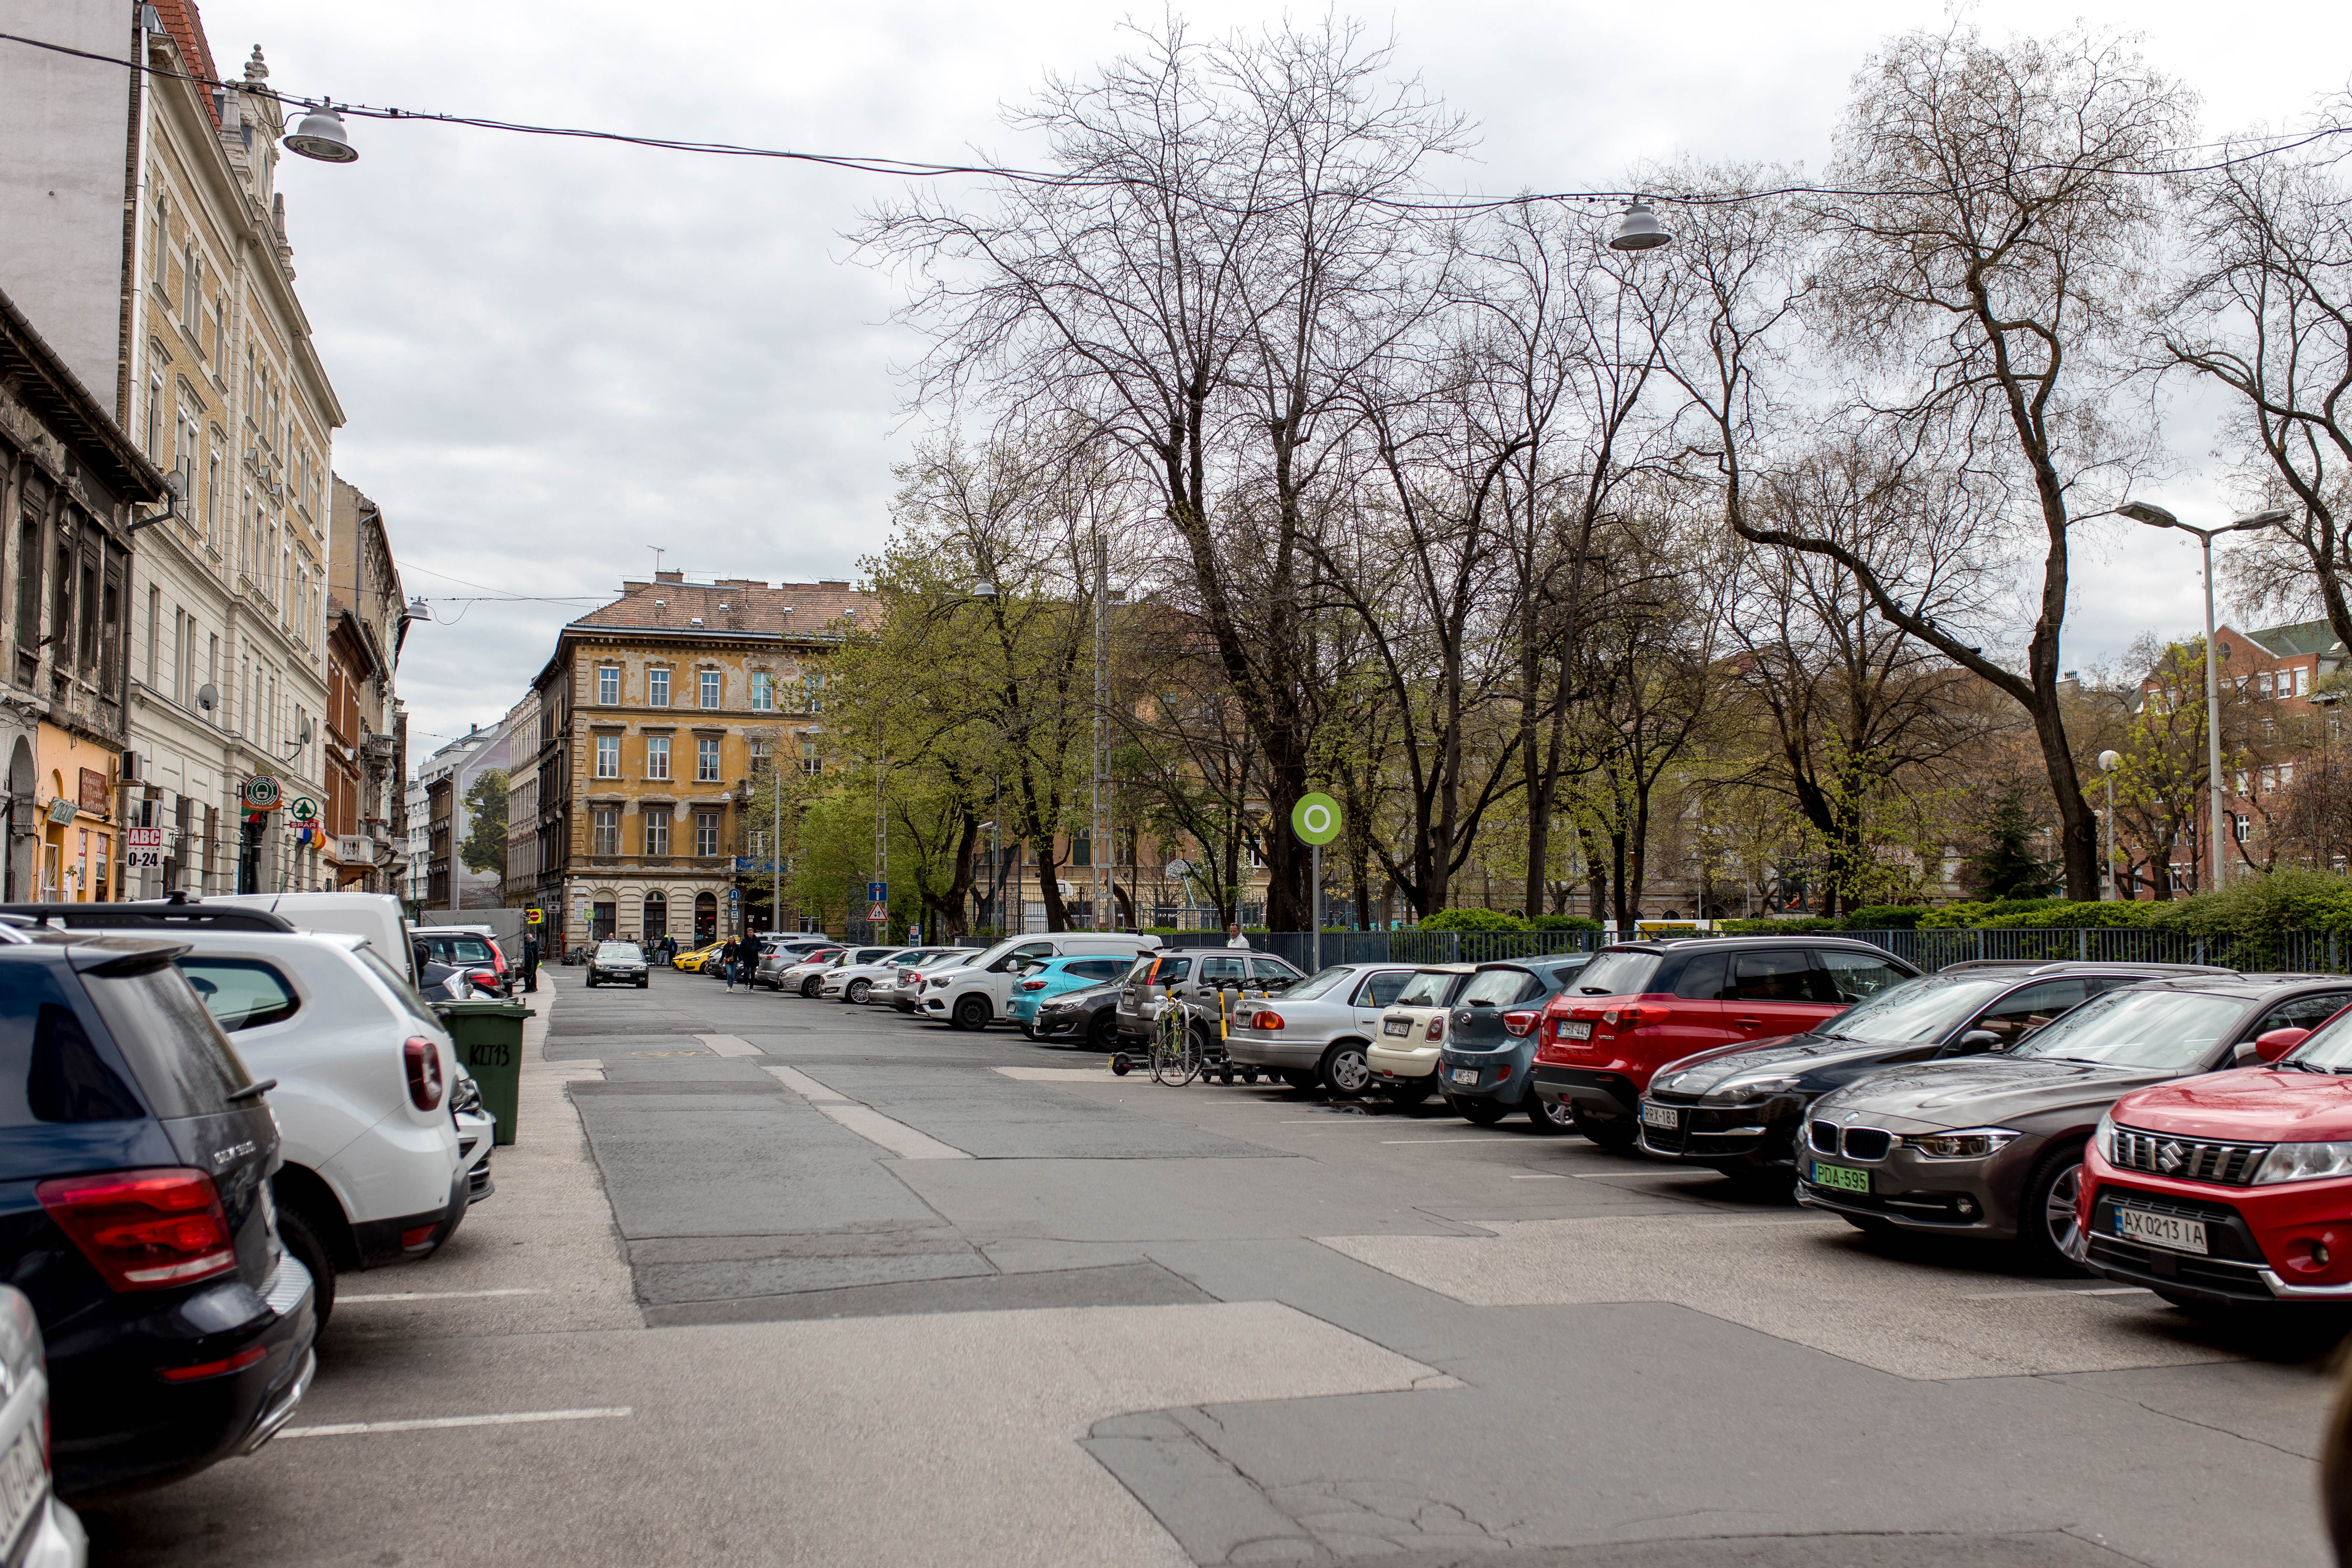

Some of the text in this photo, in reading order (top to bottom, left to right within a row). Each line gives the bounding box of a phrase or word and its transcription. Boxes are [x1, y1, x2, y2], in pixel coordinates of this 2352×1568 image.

[249, 777, 267, 787] KLAUZÁL
[248, 794, 277, 806] VÁSÁRCSARNOK
[129, 829, 160, 844] ABC
[128, 852, 158, 867] 0-24
[1388, 1023, 1407, 1033] LGF-439
[1562, 1022, 1589, 1036] PHX-443
[469, 1044, 510, 1067] KLT13
[1454, 1070, 1477, 1082] NMG-501
[1645, 1107, 1676, 1125] RRX-183
[1818, 1165, 1866, 1189] PDA-595
[2125, 1212, 2143, 1233] AX
[2146, 1216, 2179, 1240] 0213
